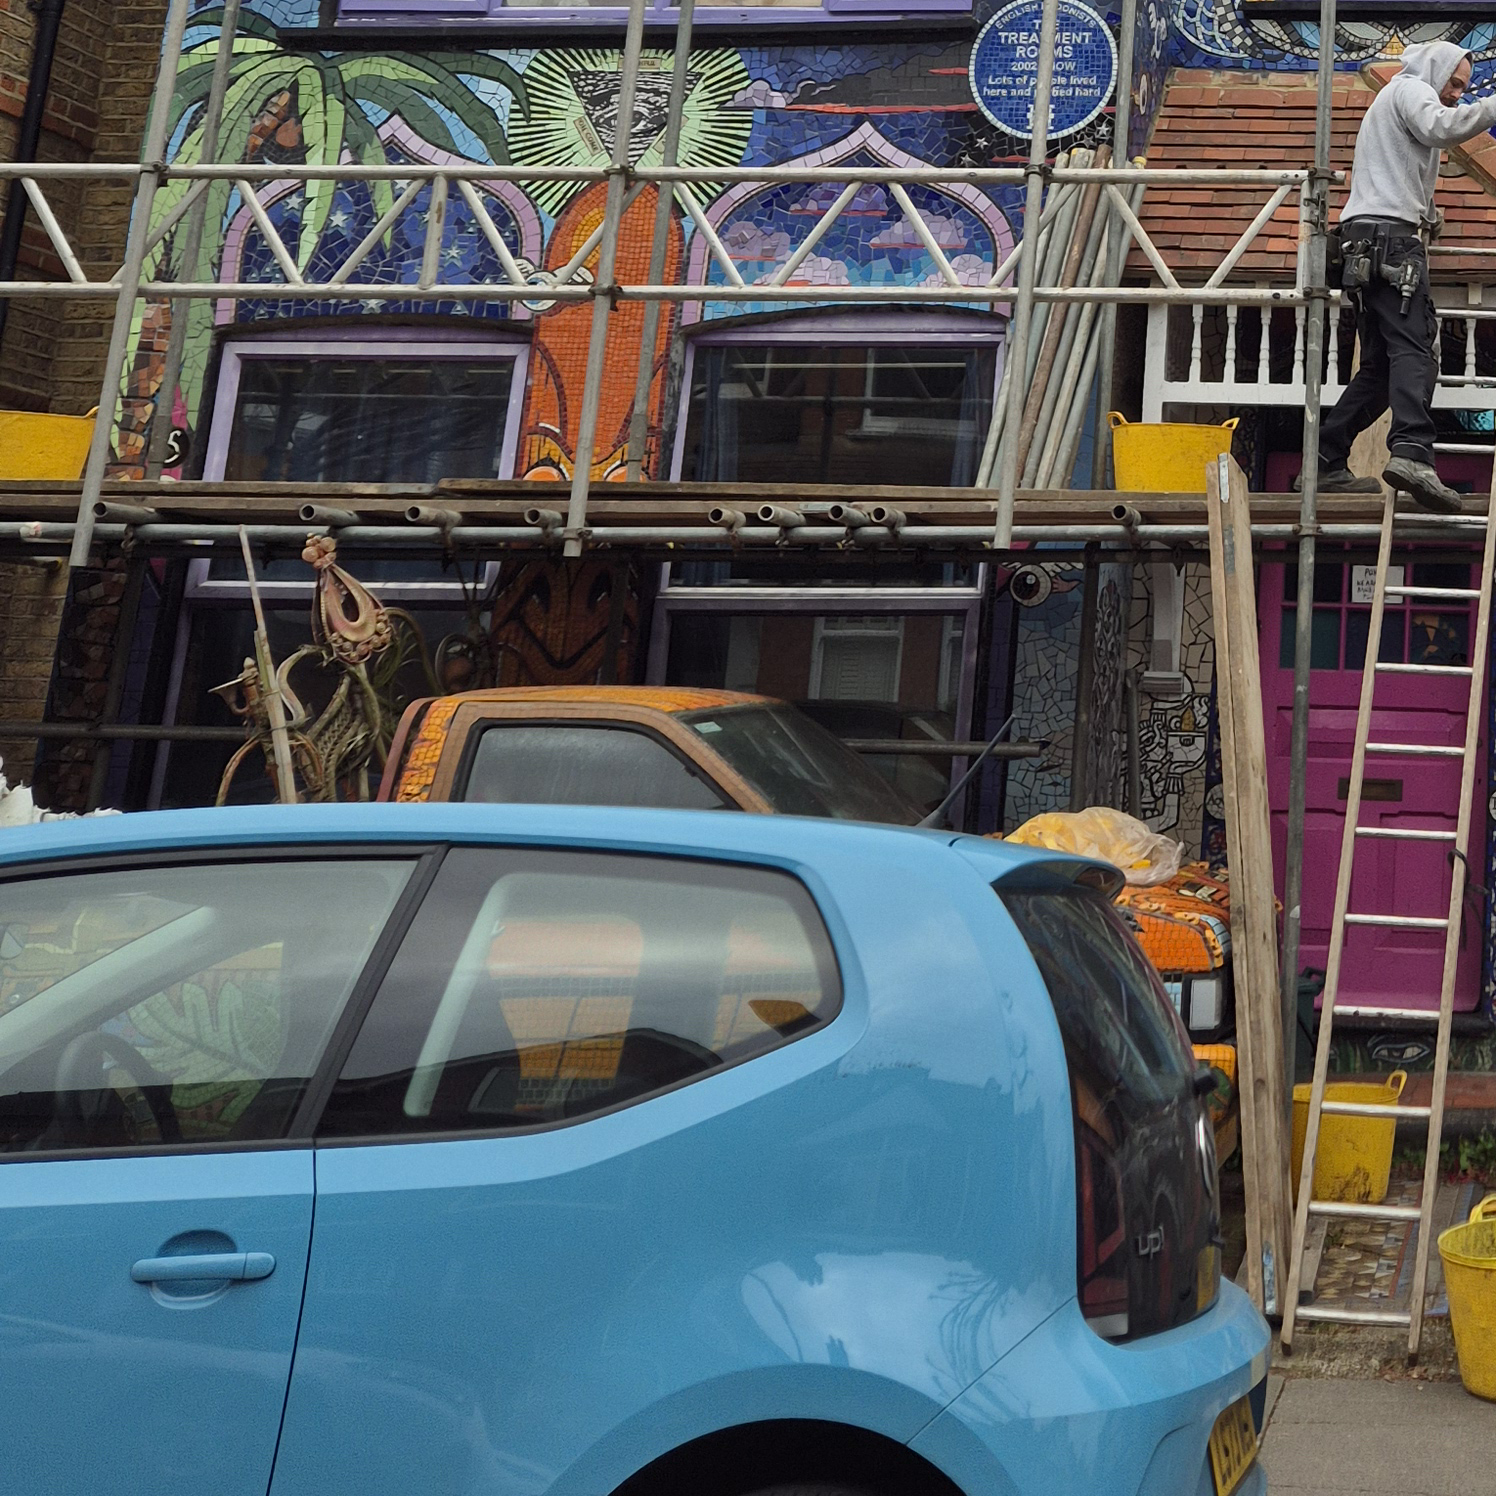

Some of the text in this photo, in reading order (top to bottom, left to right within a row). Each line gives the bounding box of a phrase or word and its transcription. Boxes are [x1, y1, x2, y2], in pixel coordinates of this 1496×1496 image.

[995, 2, 1097, 29] ENGLISH DONISTS
[1033, 20, 1060, 30] TE
[998, 32, 1092, 44] TREAMENT
[1016, 45, 1074, 58] ROMS
[1011, 61, 1038, 71] 2002
[988, 75, 1097, 86] Lots of pple lived
[983, 87, 1008, 96] here
[1010, 87, 1031, 96] and
[1075, 87, 1101, 96] hard
